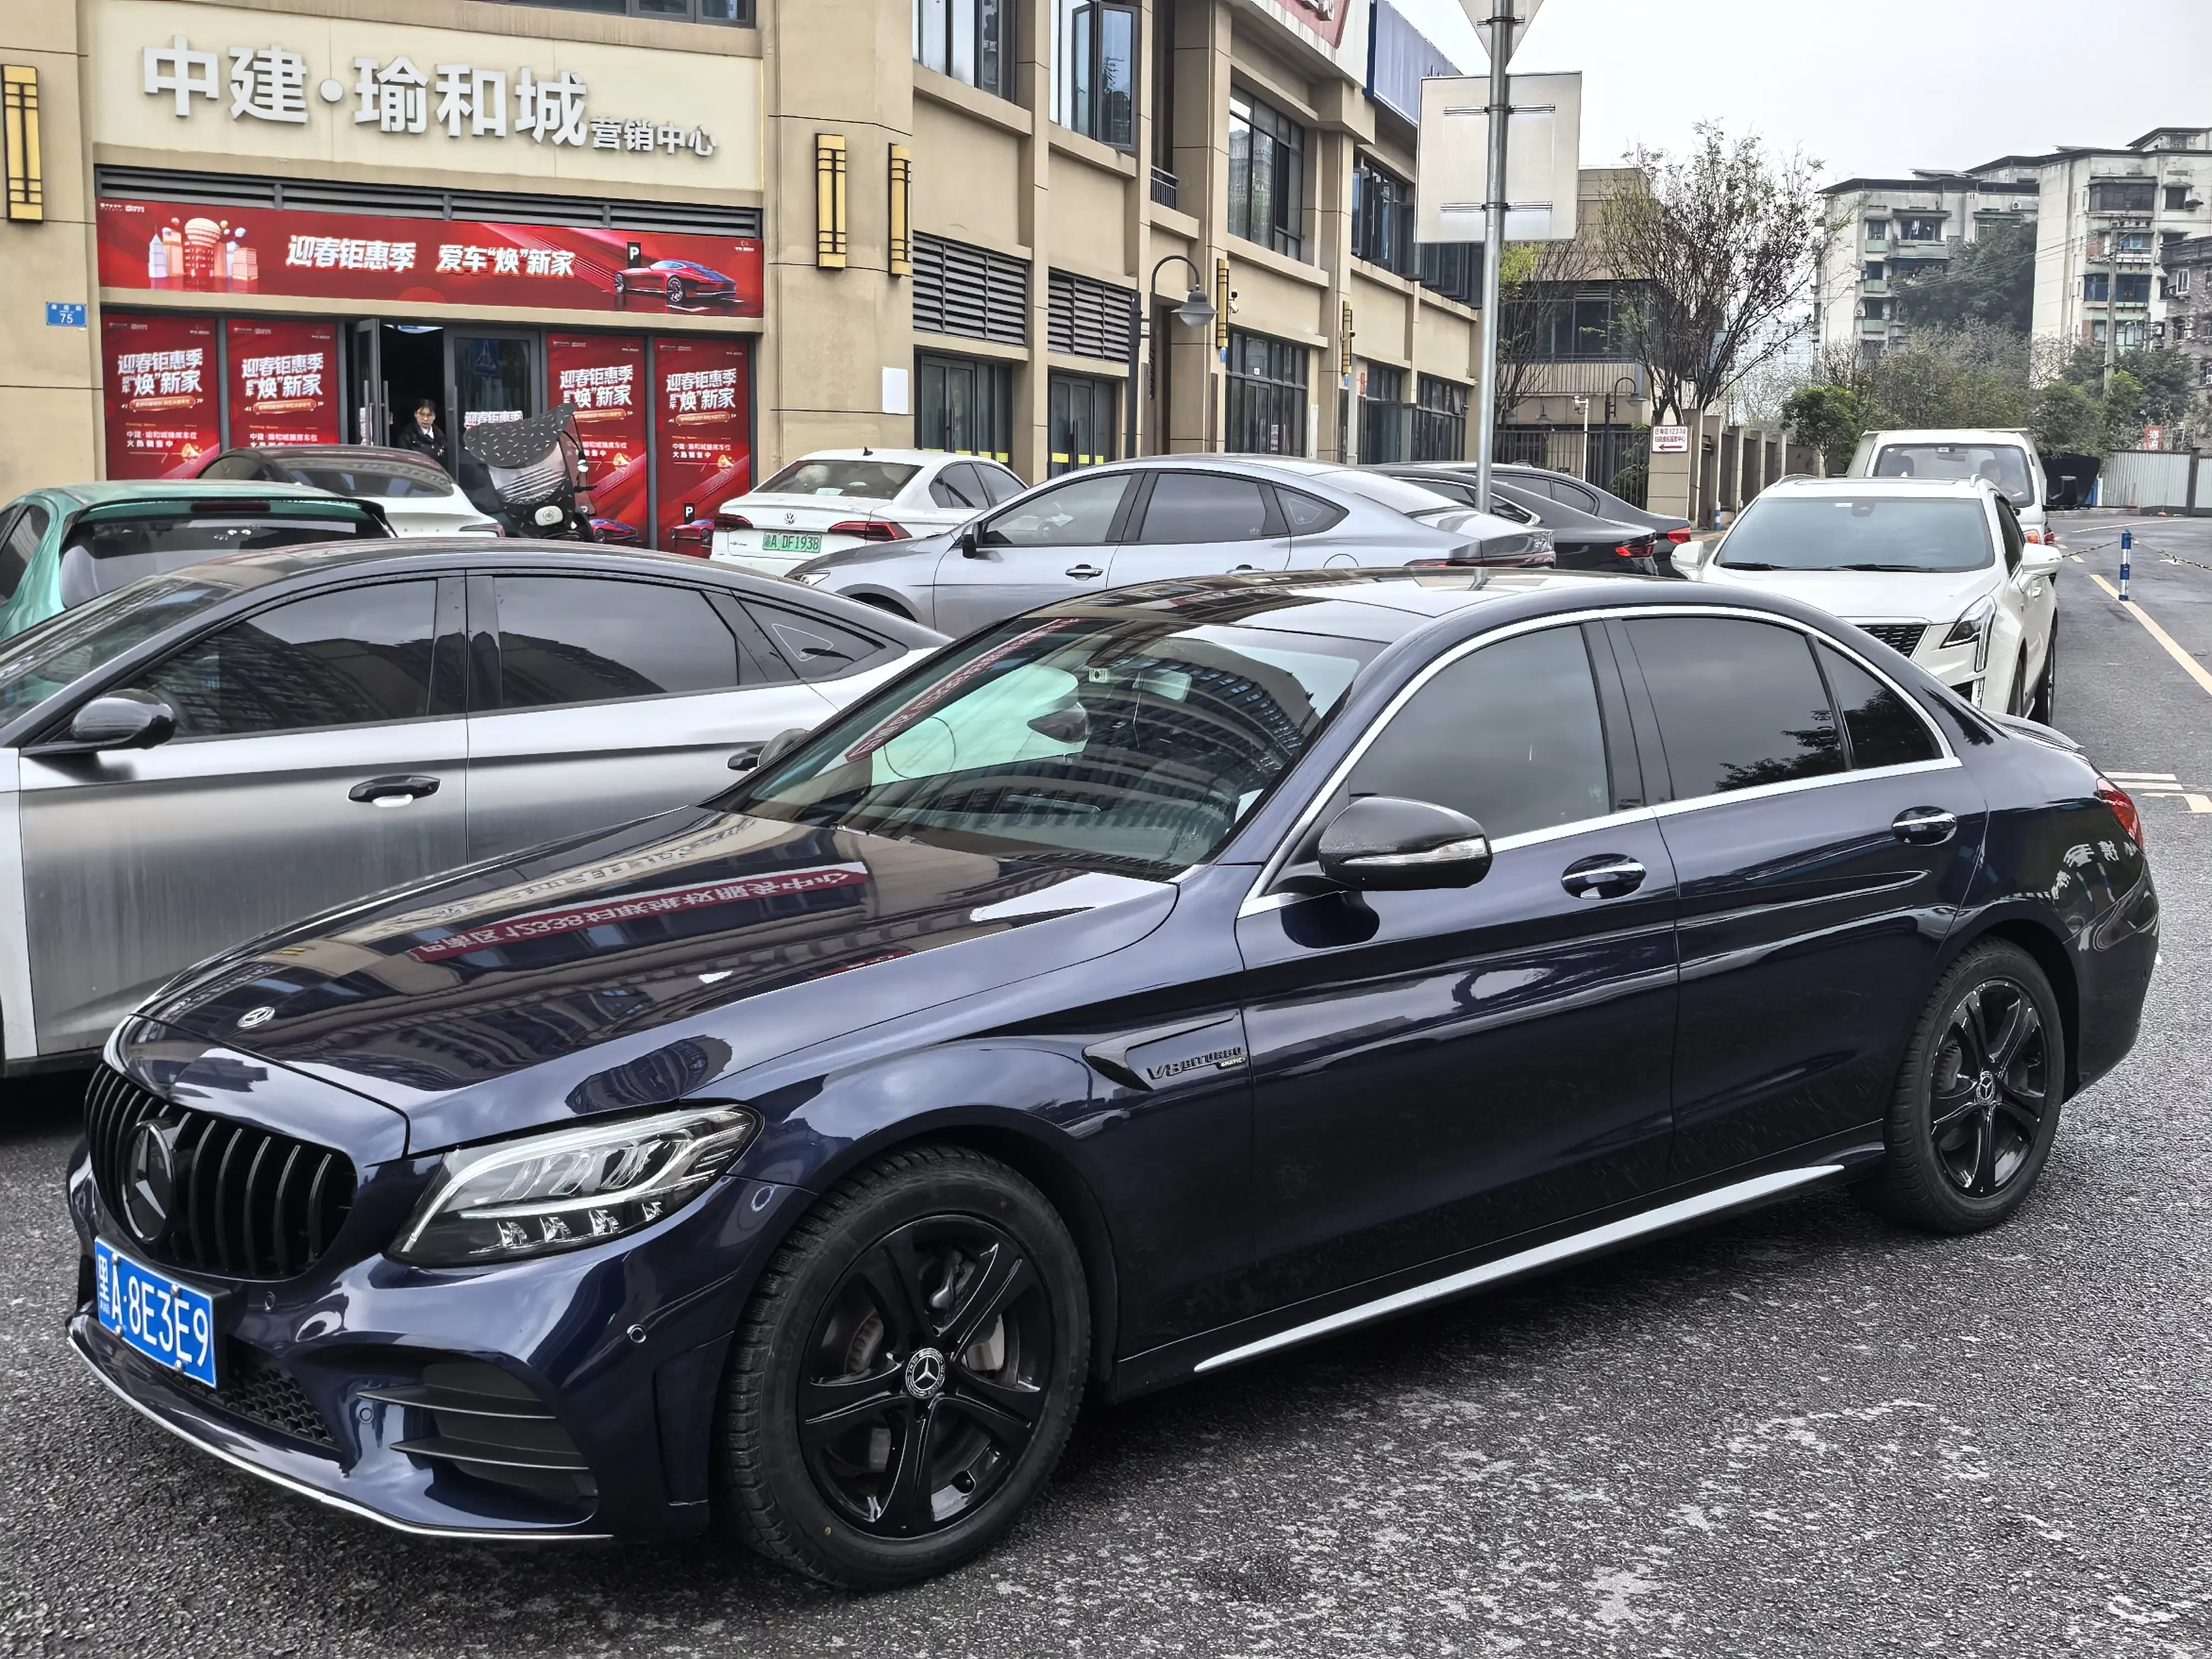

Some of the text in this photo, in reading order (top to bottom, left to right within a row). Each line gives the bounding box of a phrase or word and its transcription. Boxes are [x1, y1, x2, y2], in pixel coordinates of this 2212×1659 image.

[142, 35, 718, 157] 中建·瑜和城 营销中心
[286, 235, 416, 272] 迎春钜惠季
[630, 247, 639, 260] P
[60, 313, 73, 323] 75
[118, 348, 203, 375] 迎春钜惠季
[241, 353, 323, 379] 迎春钜惠季
[559, 365, 633, 389] 迎春钜惠季
[666, 368, 737, 393] 迎春钜惠季
[686, 507, 693, 517] P
